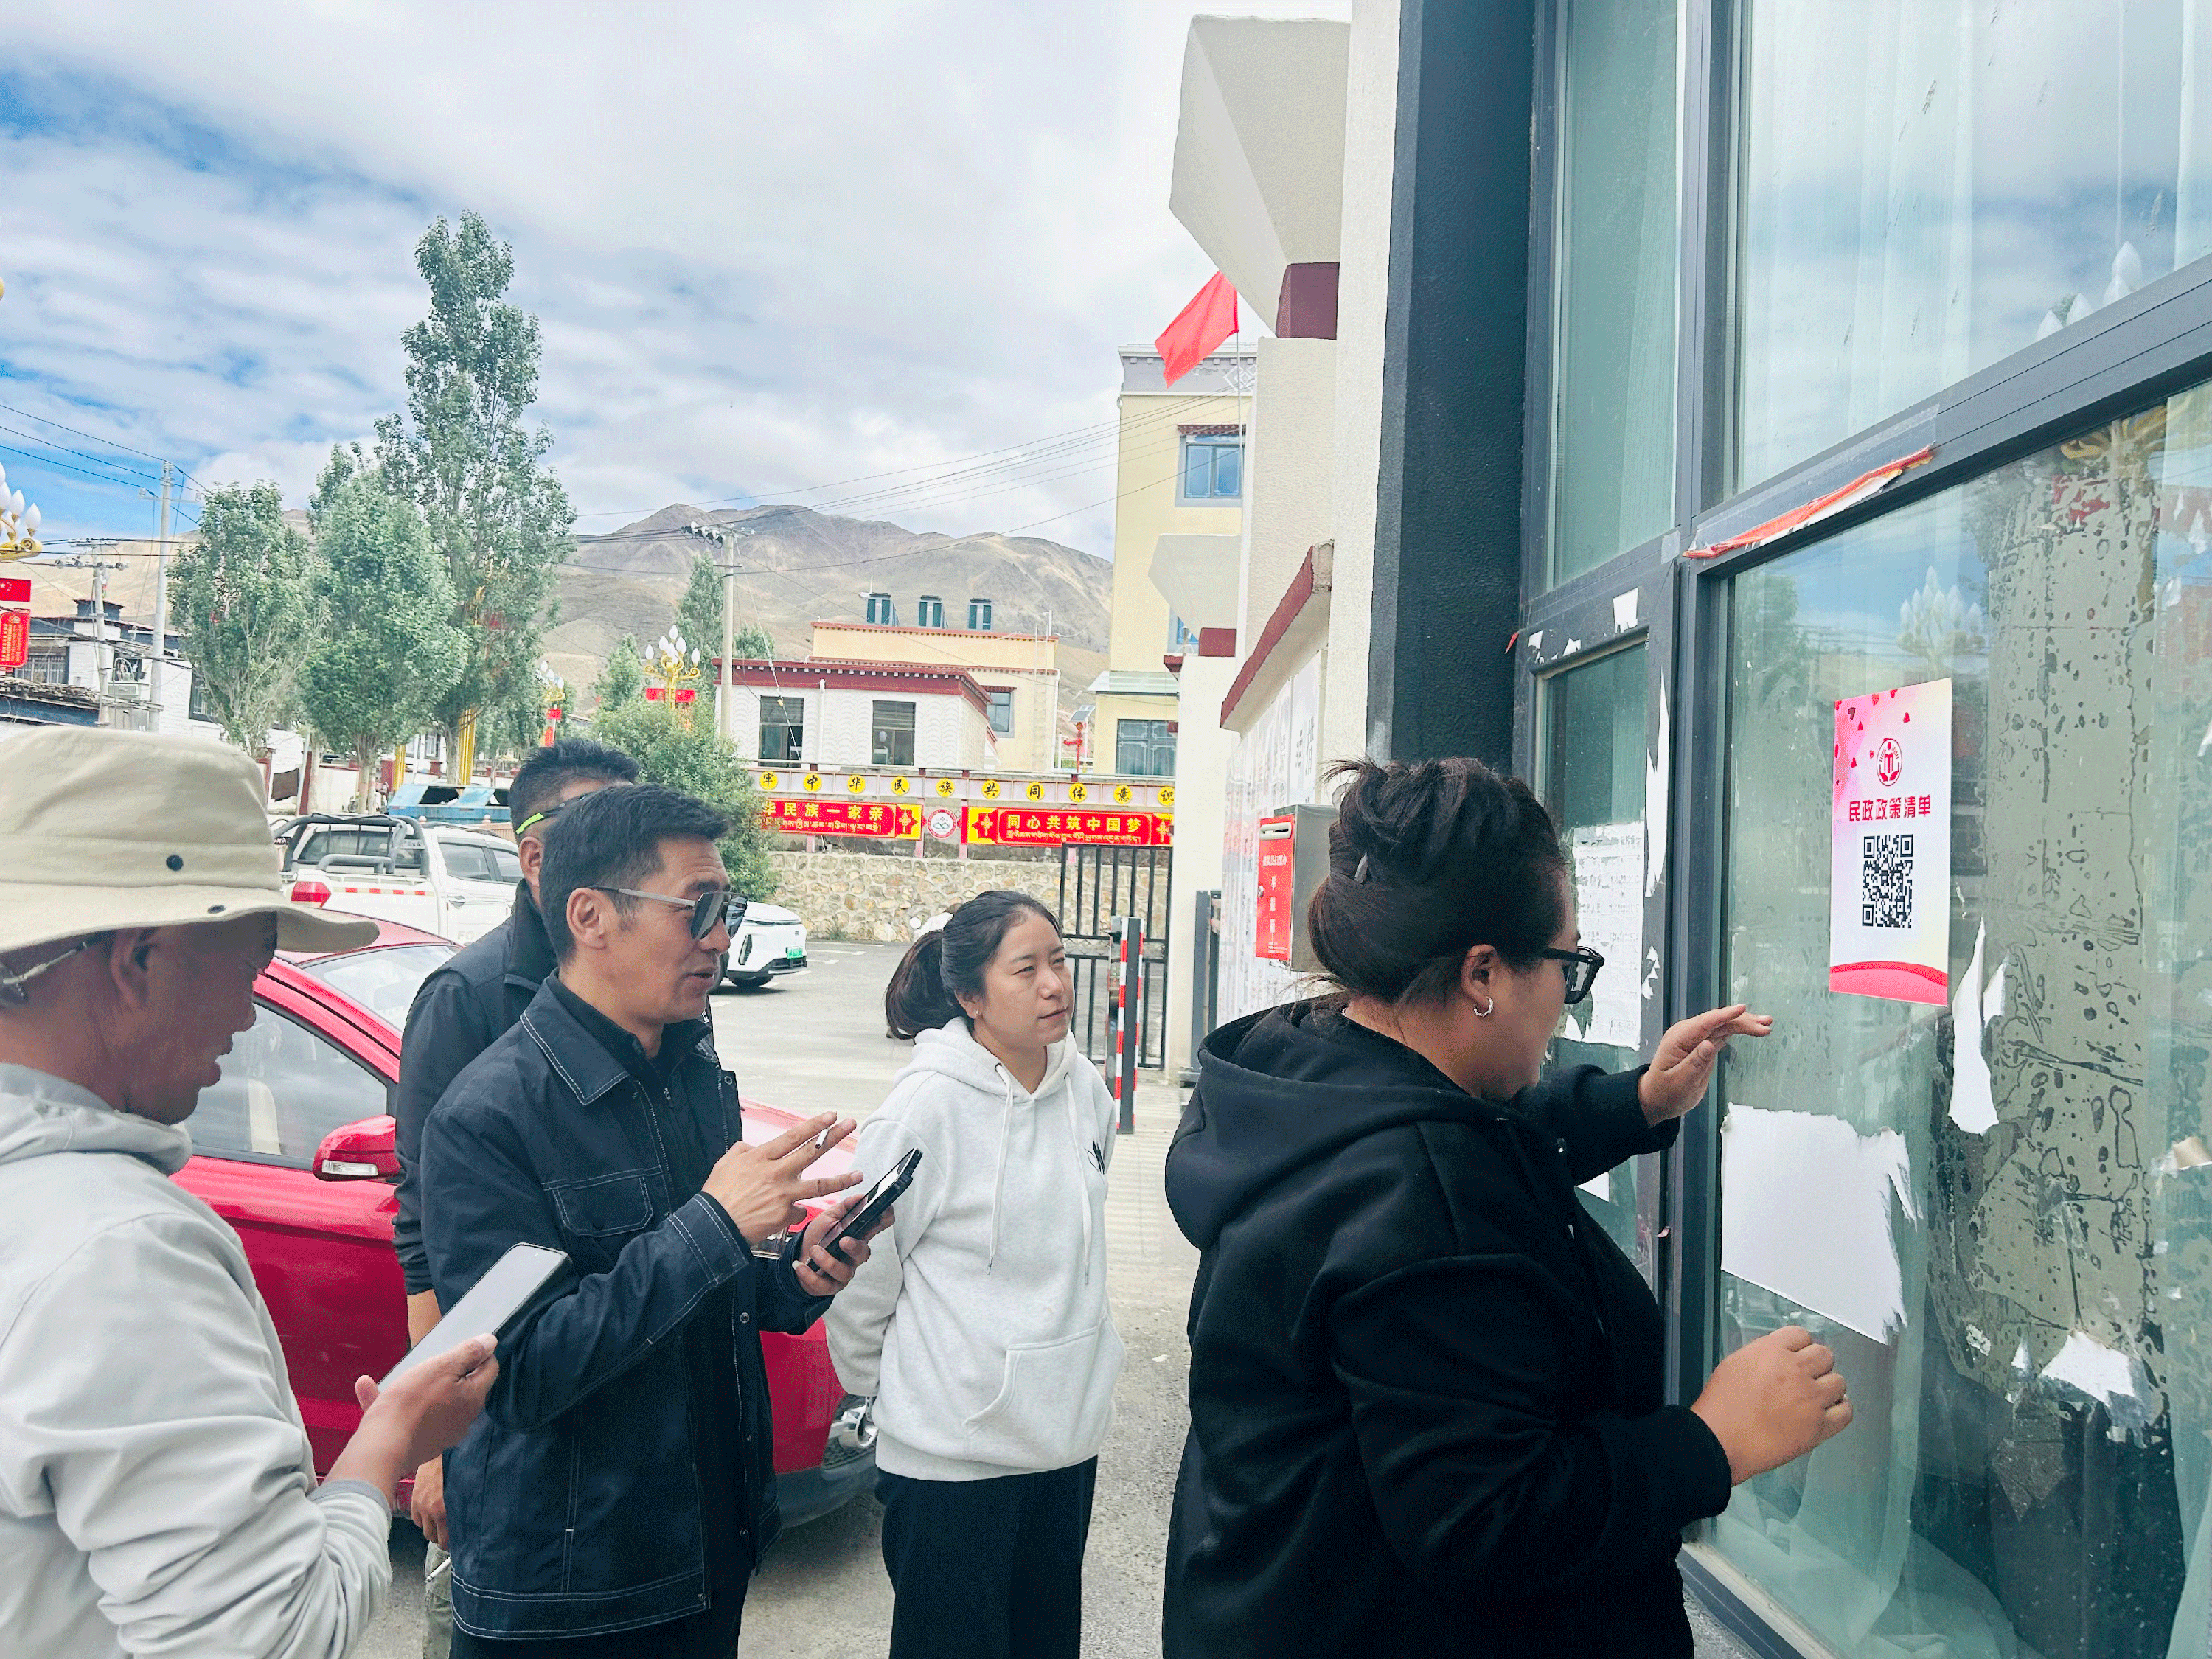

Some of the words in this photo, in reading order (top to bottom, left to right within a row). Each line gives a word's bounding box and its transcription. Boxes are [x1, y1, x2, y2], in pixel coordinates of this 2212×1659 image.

[1849, 795, 1931, 822] 民政政策清单
[1007, 814, 1141, 833] 同心共筑中国梦
